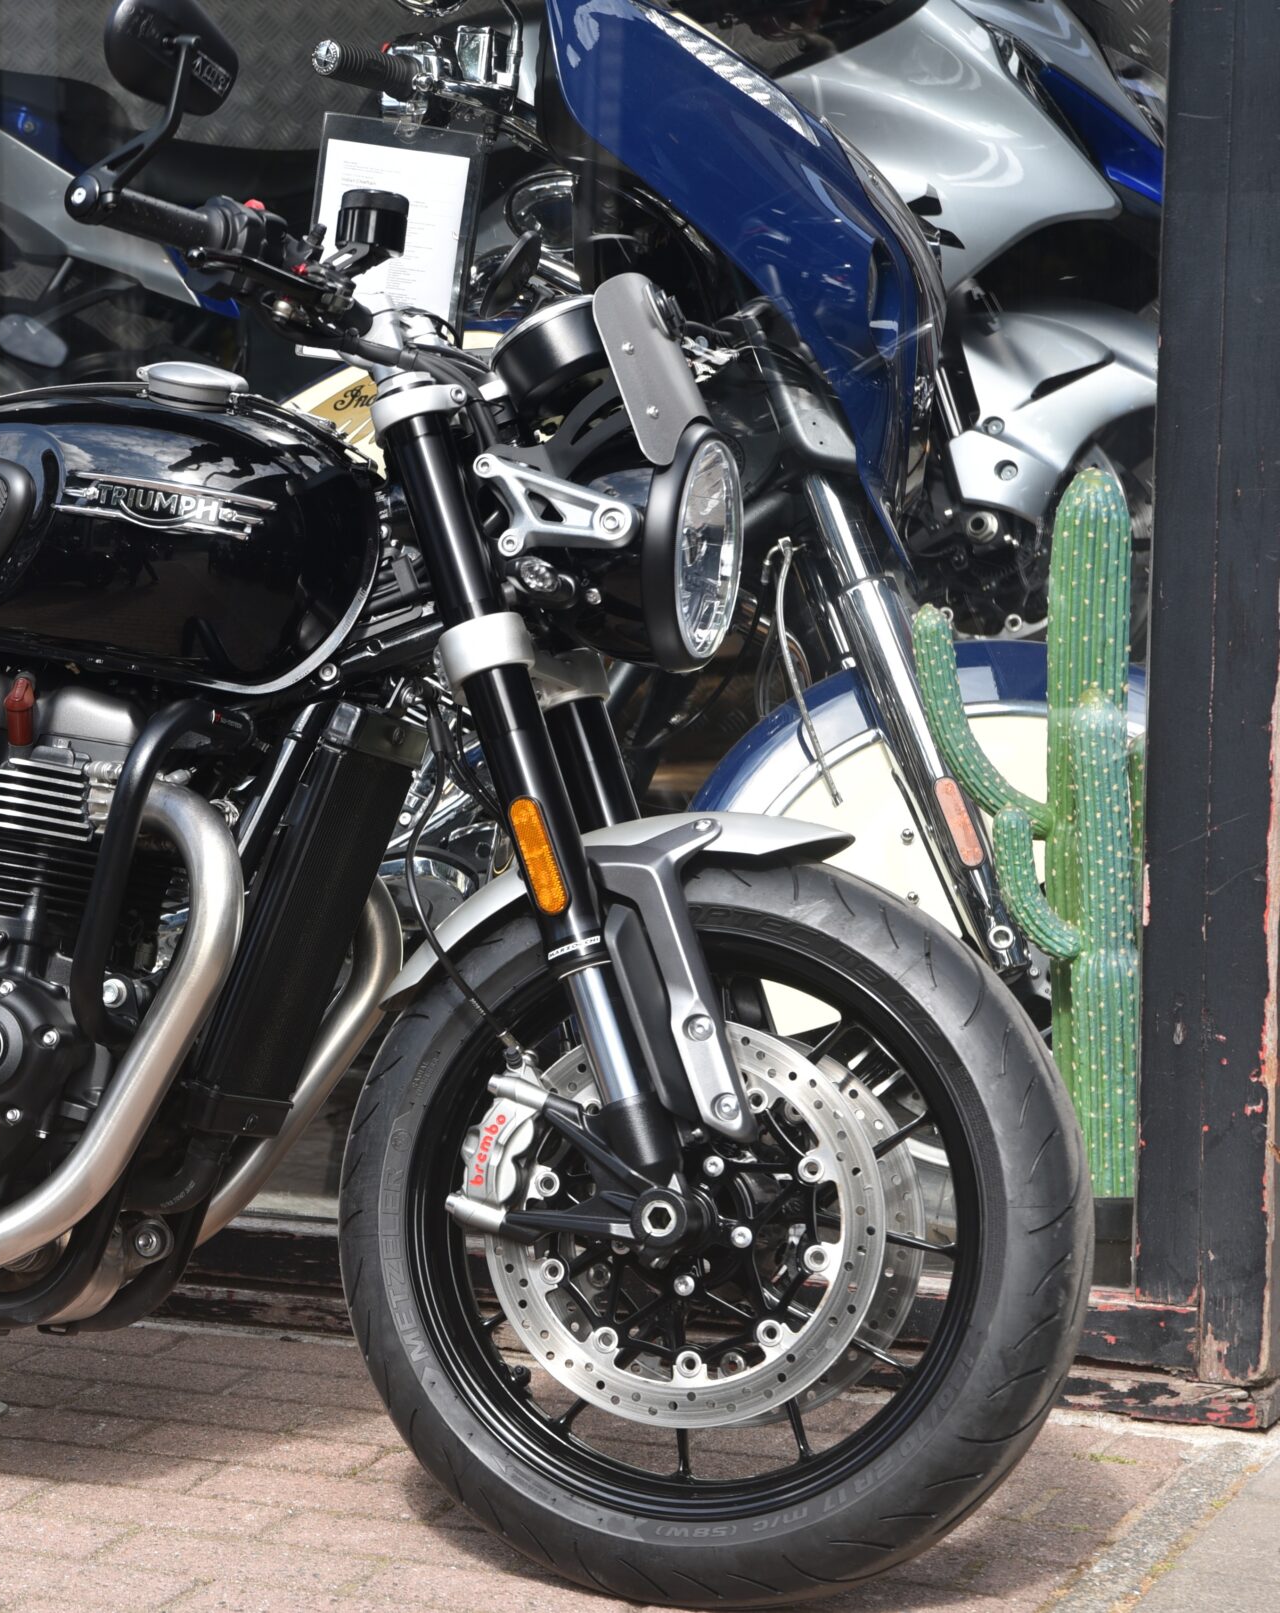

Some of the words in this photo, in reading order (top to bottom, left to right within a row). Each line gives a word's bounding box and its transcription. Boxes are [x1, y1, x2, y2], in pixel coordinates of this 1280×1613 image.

[96, 483, 219, 522] TRIUMPH
[549, 937, 599, 958] MARZOCHI
[470, 1114, 506, 1186] brembo
[380, 1166, 429, 1362] METZELER
[655, 1521, 738, 1540] (58W)
